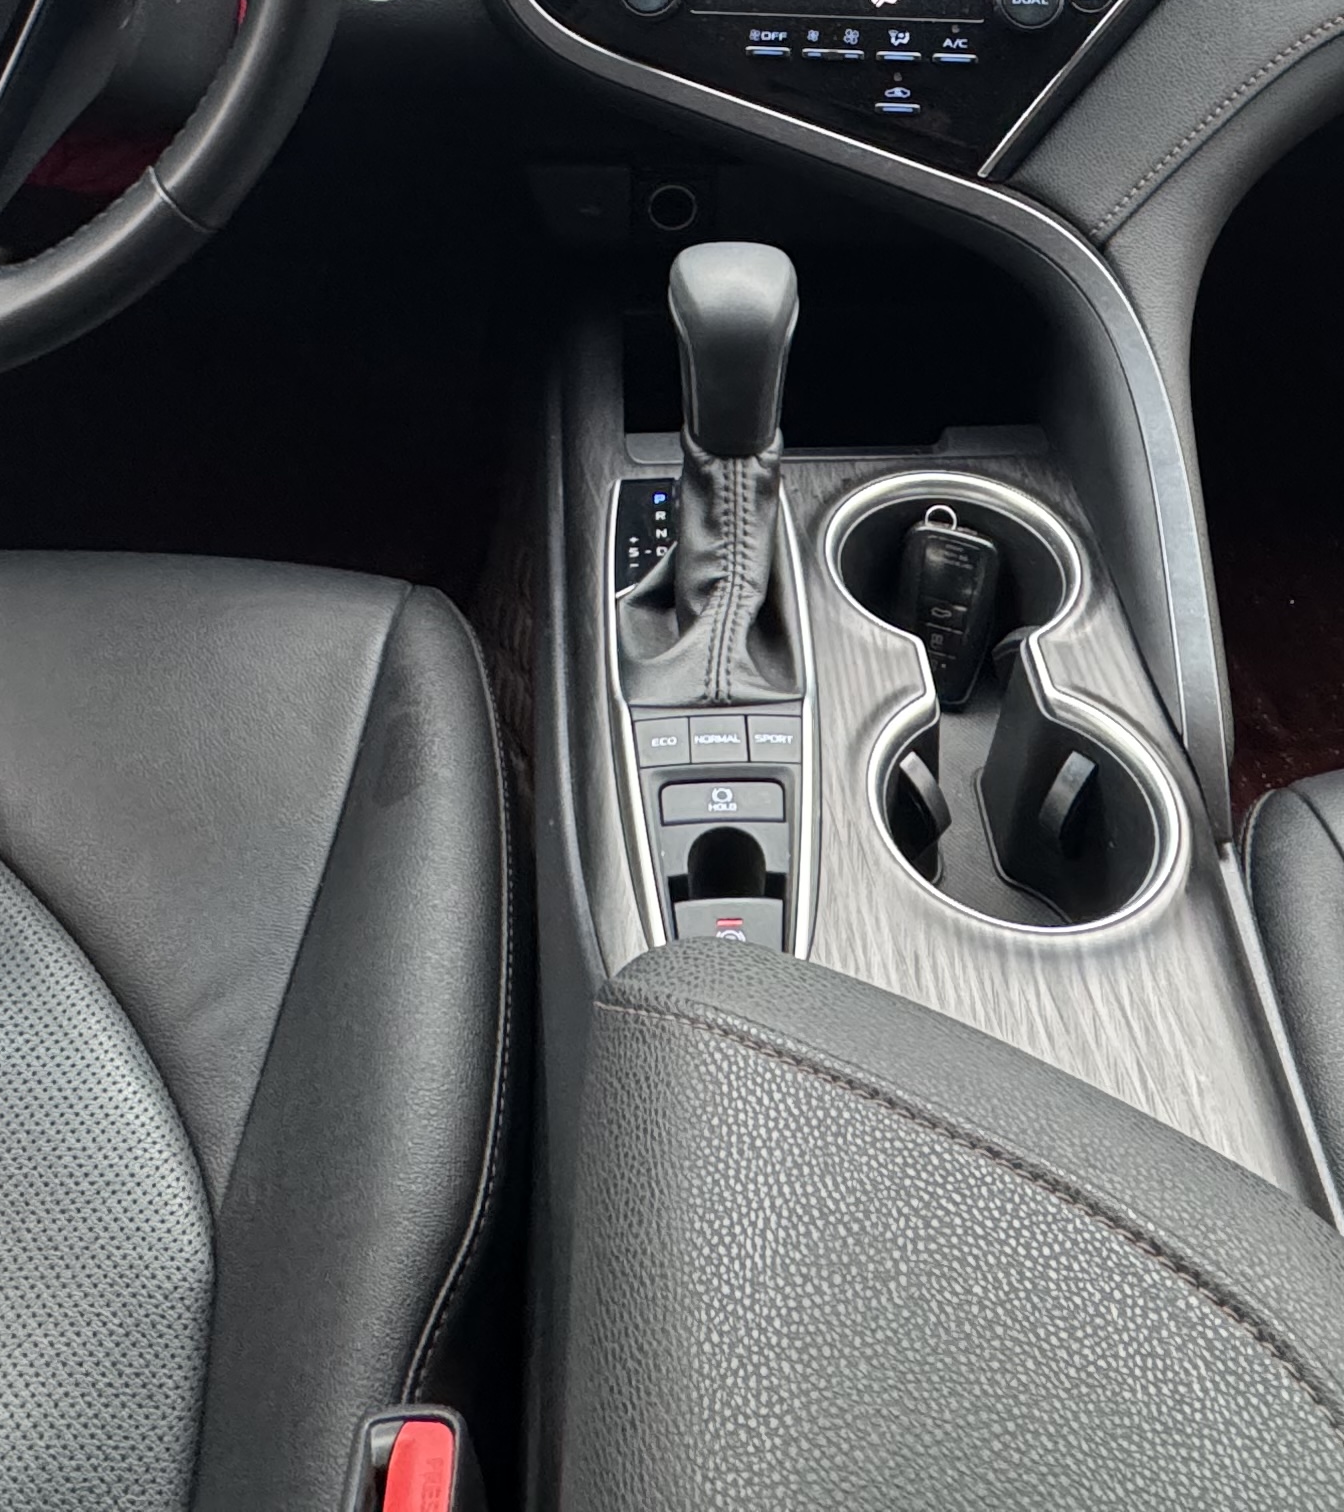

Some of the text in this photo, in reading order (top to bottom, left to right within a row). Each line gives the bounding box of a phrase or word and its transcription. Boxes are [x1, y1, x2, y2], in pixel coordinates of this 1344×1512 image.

[761, 30, 788, 41] OFF
[942, 38, 968, 49] A/C
[653, 493, 666, 505] P
[655, 510, 667, 521] R
[655, 528, 668, 539] N
[628, 547, 640, 558] S
[651, 736, 678, 748] ECO
[694, 734, 742, 745] NORMAL
[754, 734, 794, 745] SPORT
[708, 802, 738, 812] HOLD
